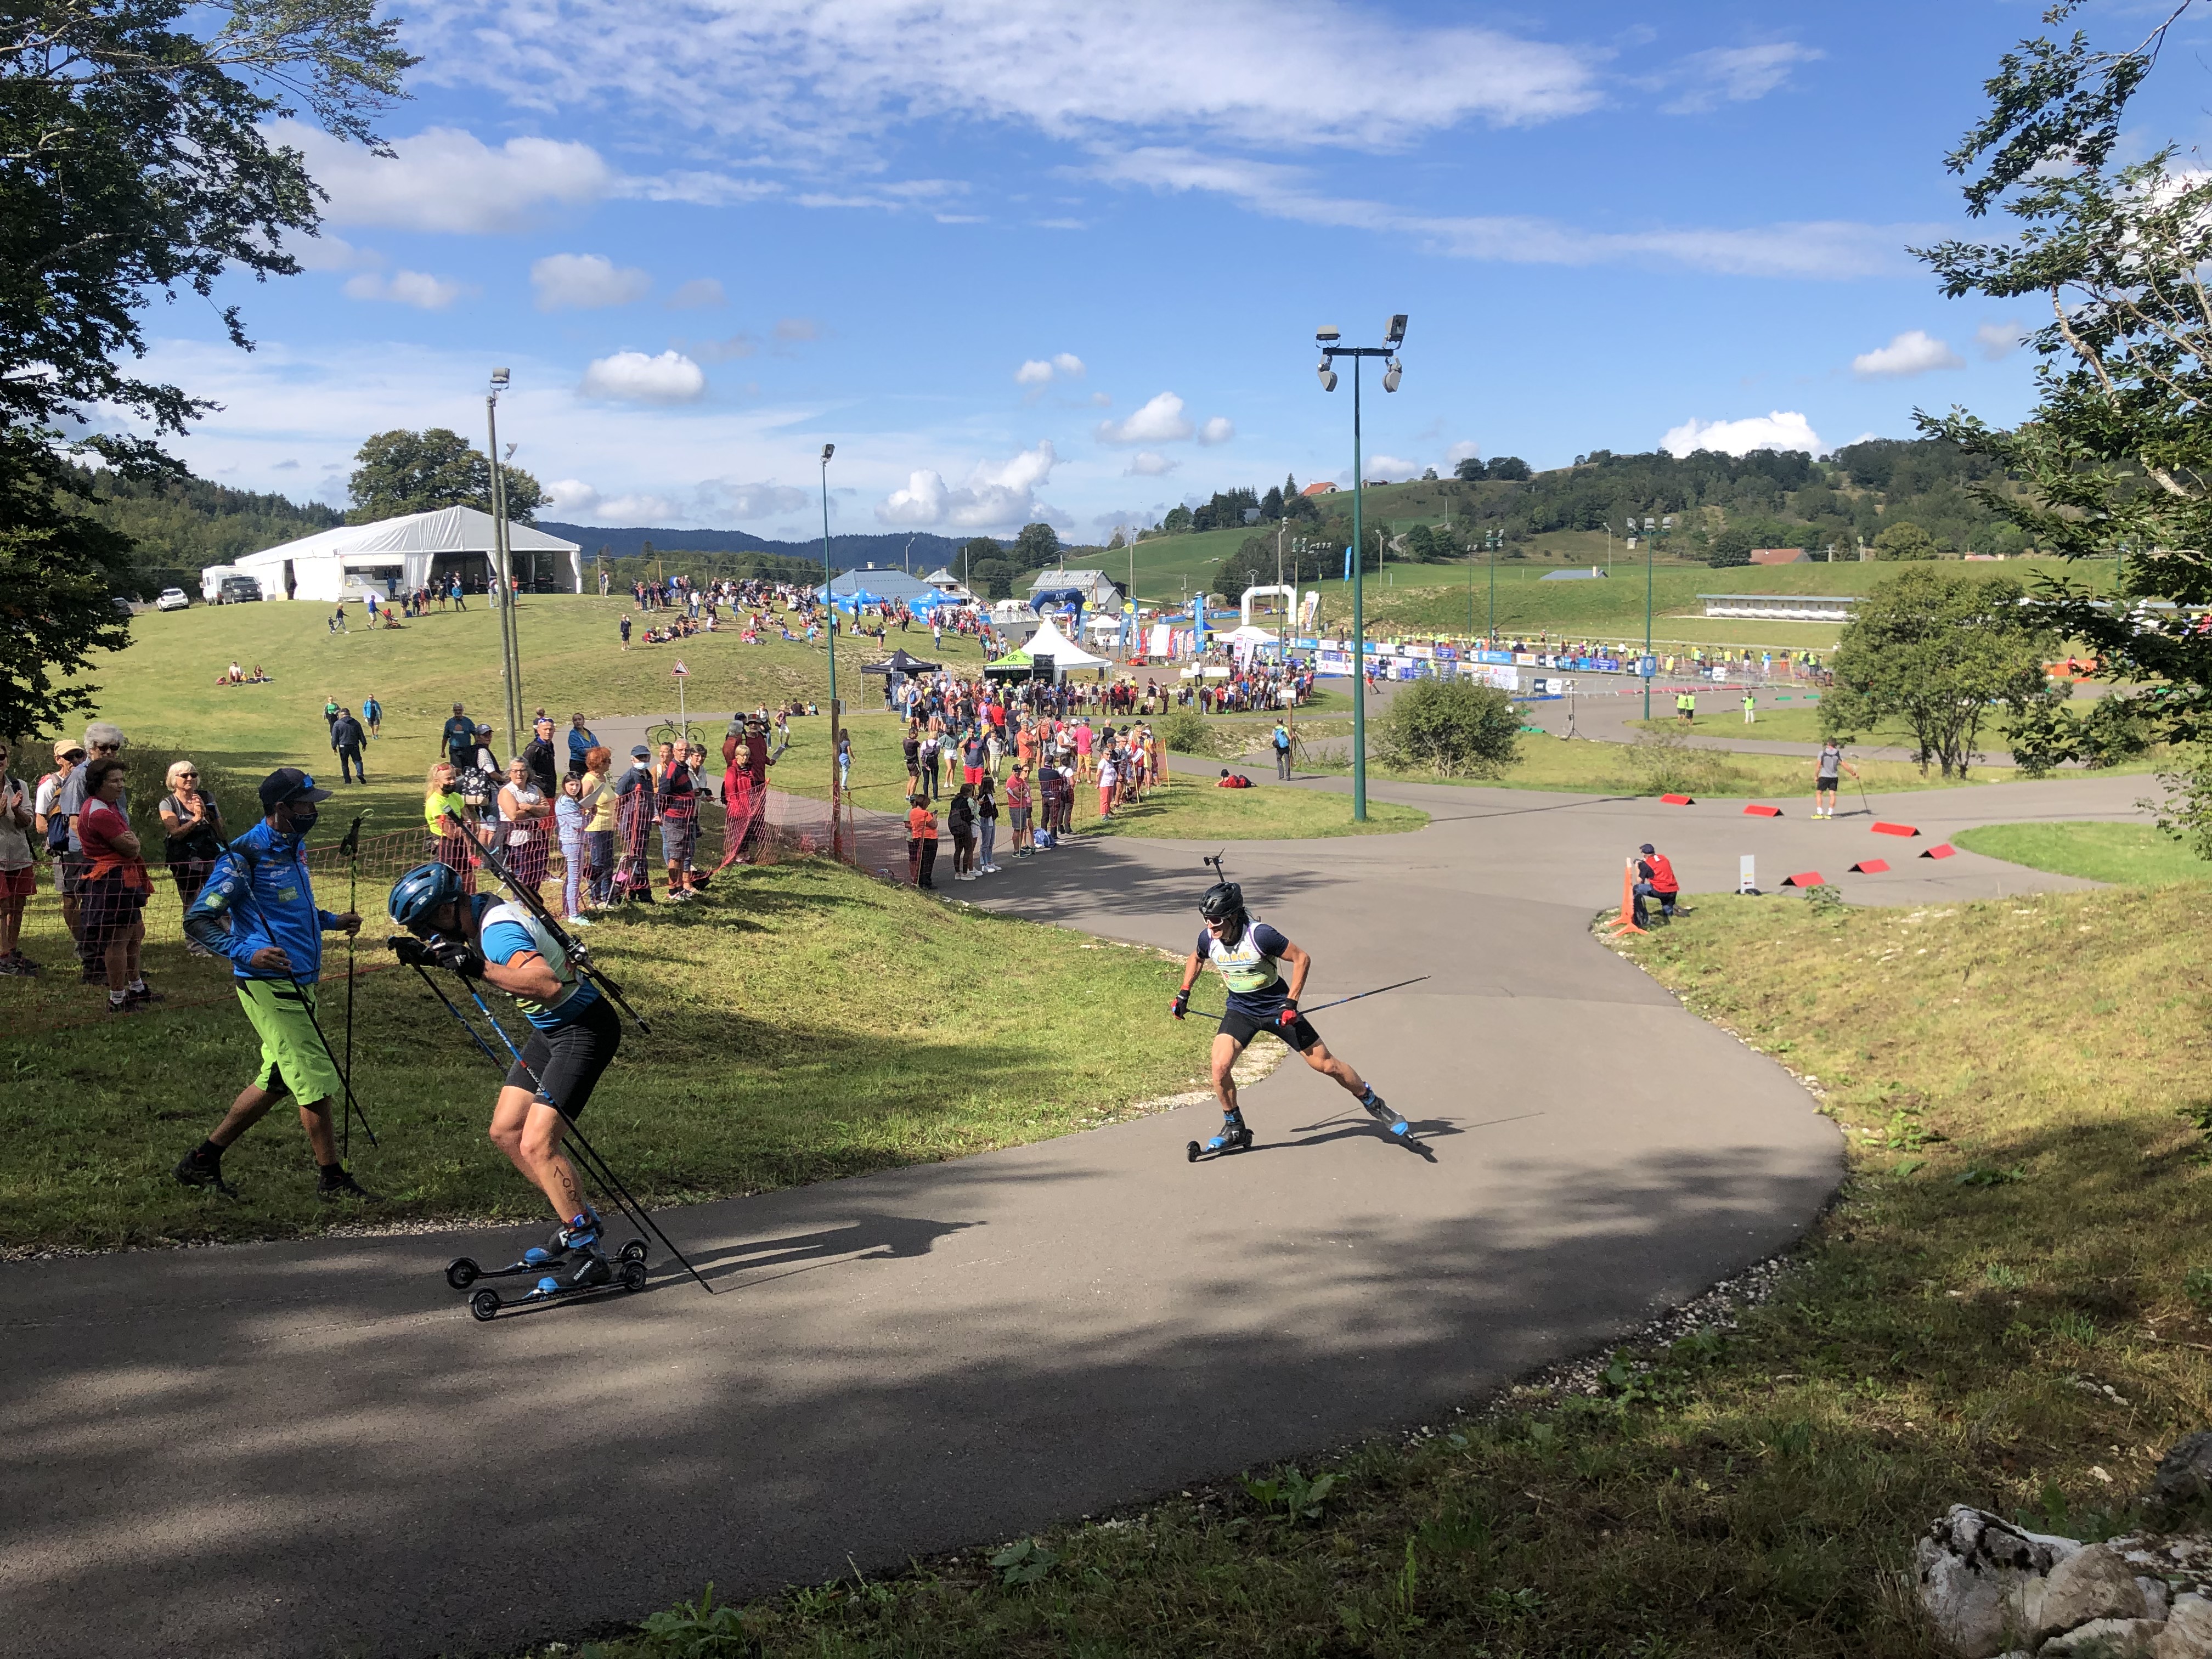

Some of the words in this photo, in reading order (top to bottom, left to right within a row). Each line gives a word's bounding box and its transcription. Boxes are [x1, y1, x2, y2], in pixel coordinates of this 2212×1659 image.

[1054, 592, 1066, 601] AIN
[278, 890, 296, 901] mgen
[1217, 951, 1252, 963] SAMSE
[554, 1166, 581, 1202] 102
